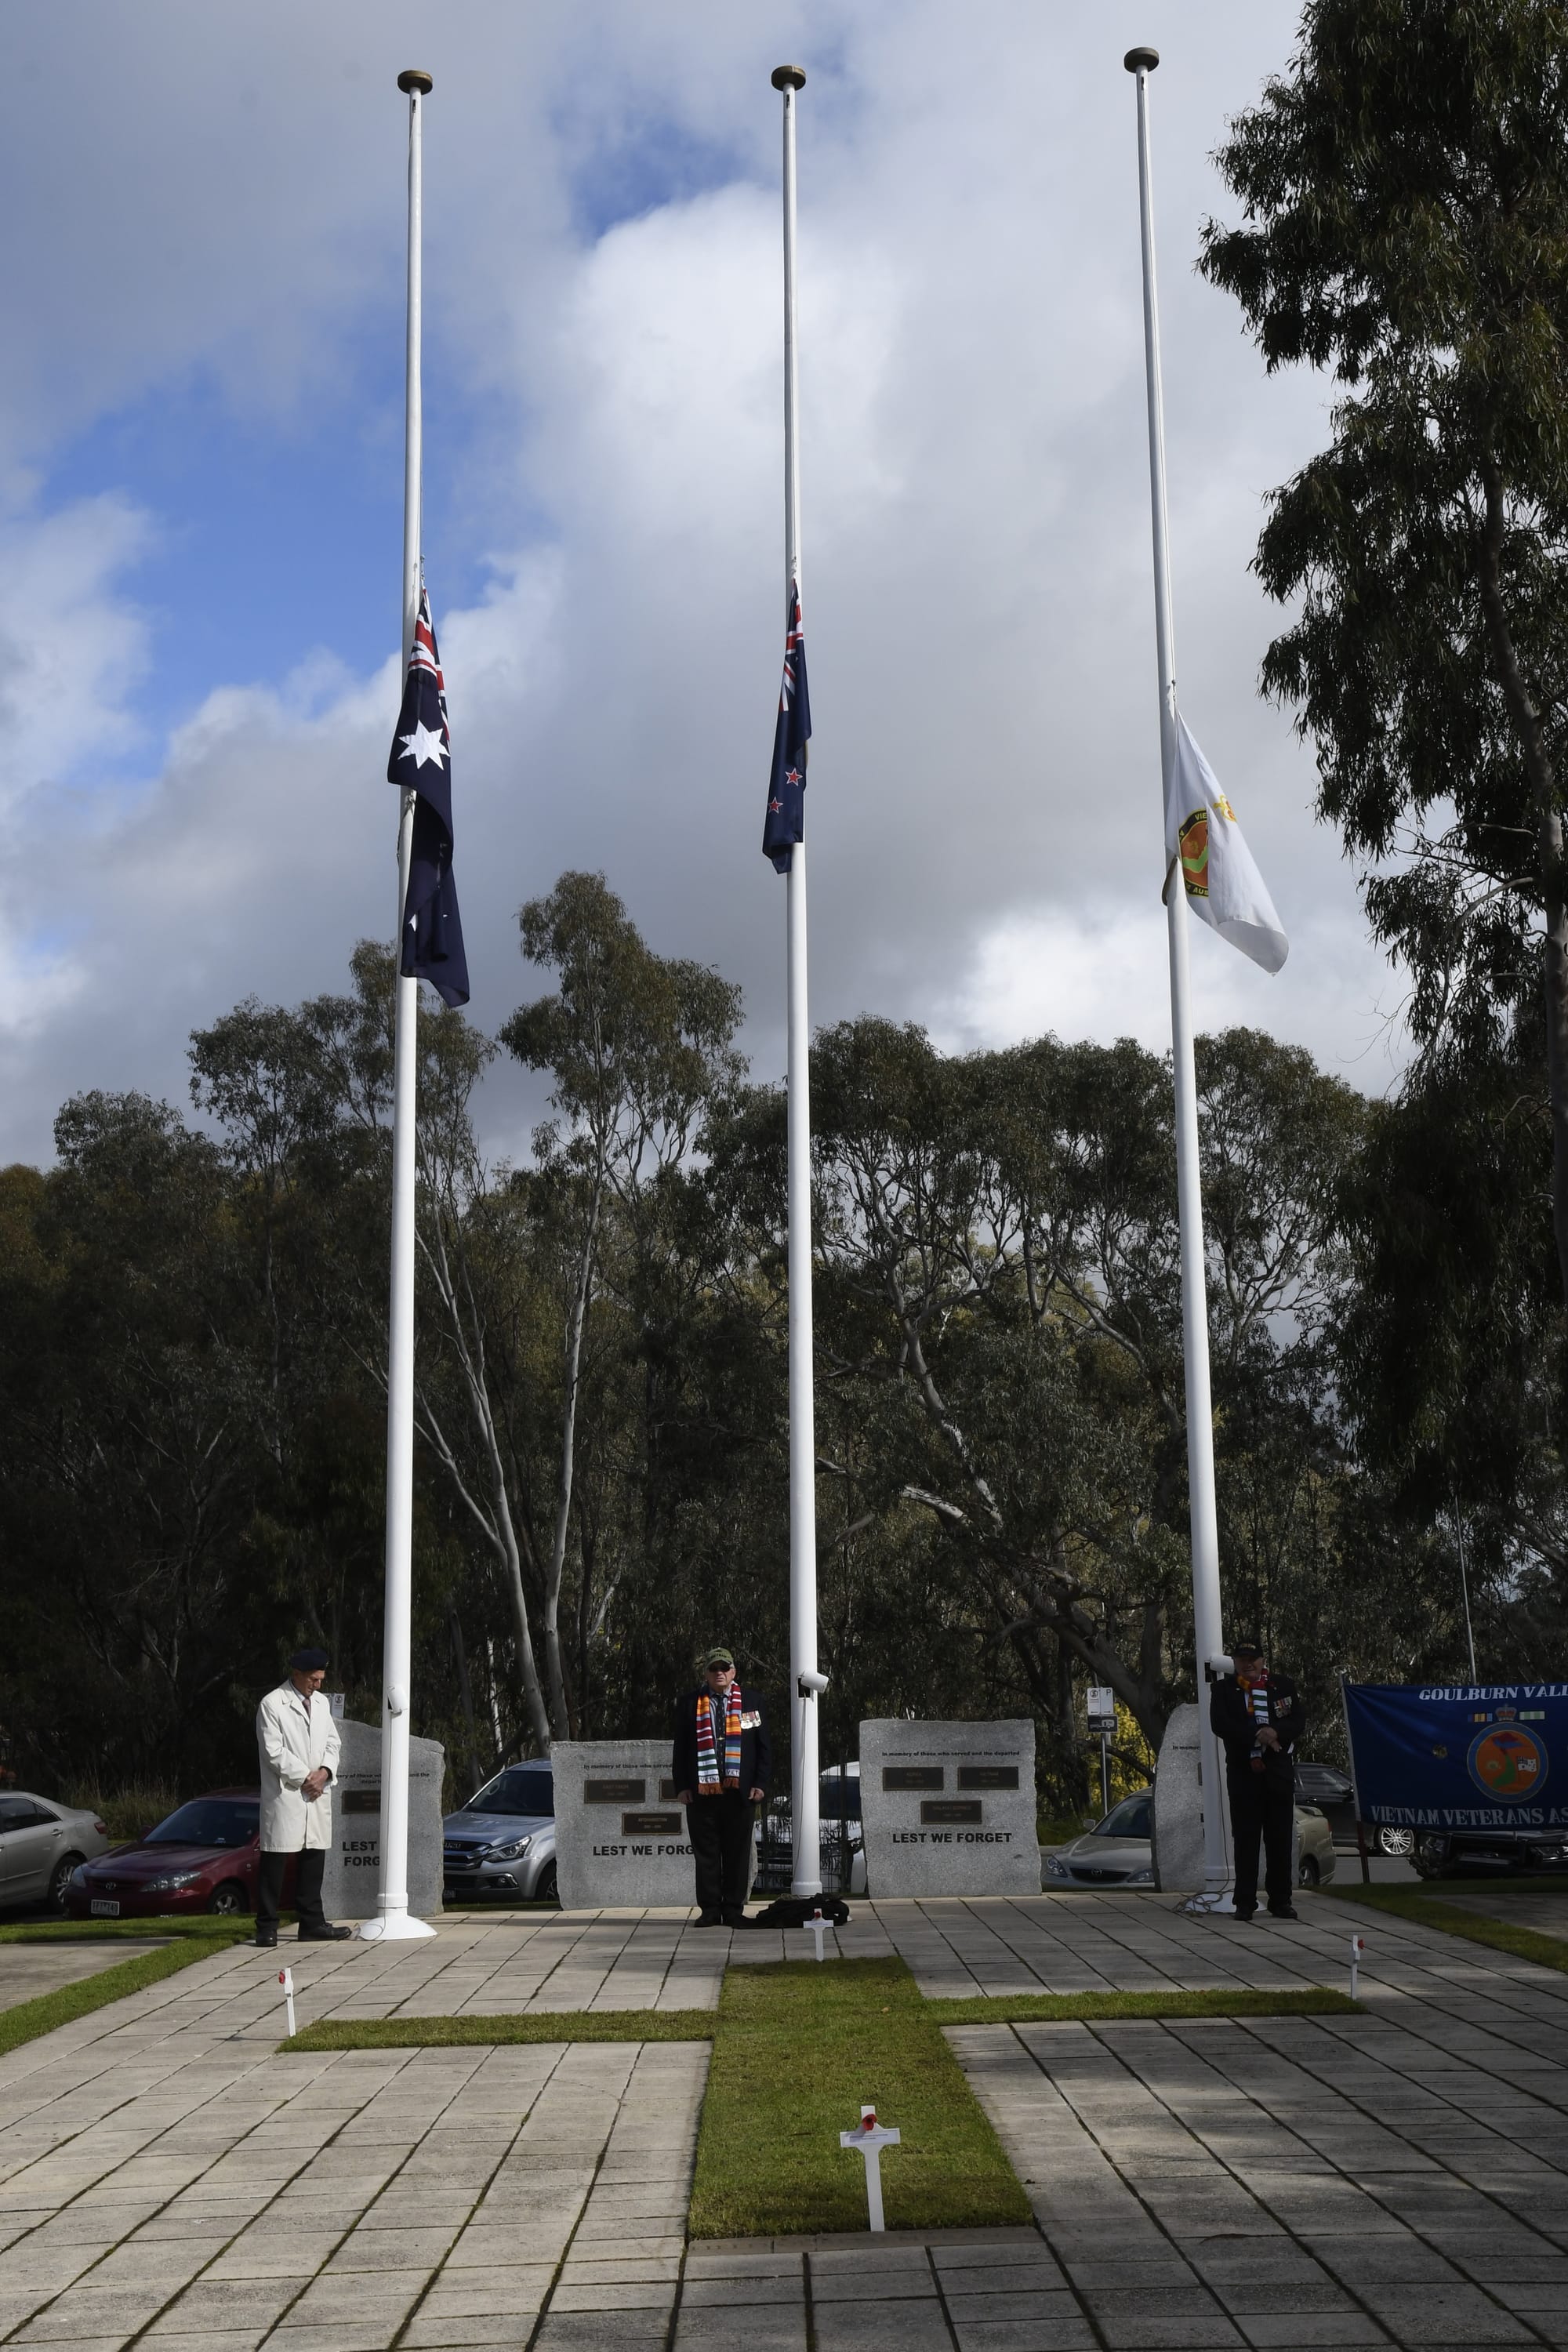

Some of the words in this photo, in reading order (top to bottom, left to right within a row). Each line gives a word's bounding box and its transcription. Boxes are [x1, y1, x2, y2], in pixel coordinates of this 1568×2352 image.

[1418, 1687, 1518, 1700] GOULBURN
[1370, 1806, 1440, 1826] VIETNAM
[1442, 1807, 1544, 1826] VETERANS
[892, 1833, 927, 1843] LEST
[931, 1833, 953, 1843] WE
[956, 1832, 1012, 1843] FORGET
[342, 1841, 377, 1852] LEST
[593, 1846, 628, 1856] LEST
[631, 1845, 653, 1856] WE
[657, 1845, 696, 1855] FORG
[343, 1856, 380, 1867] FORG
